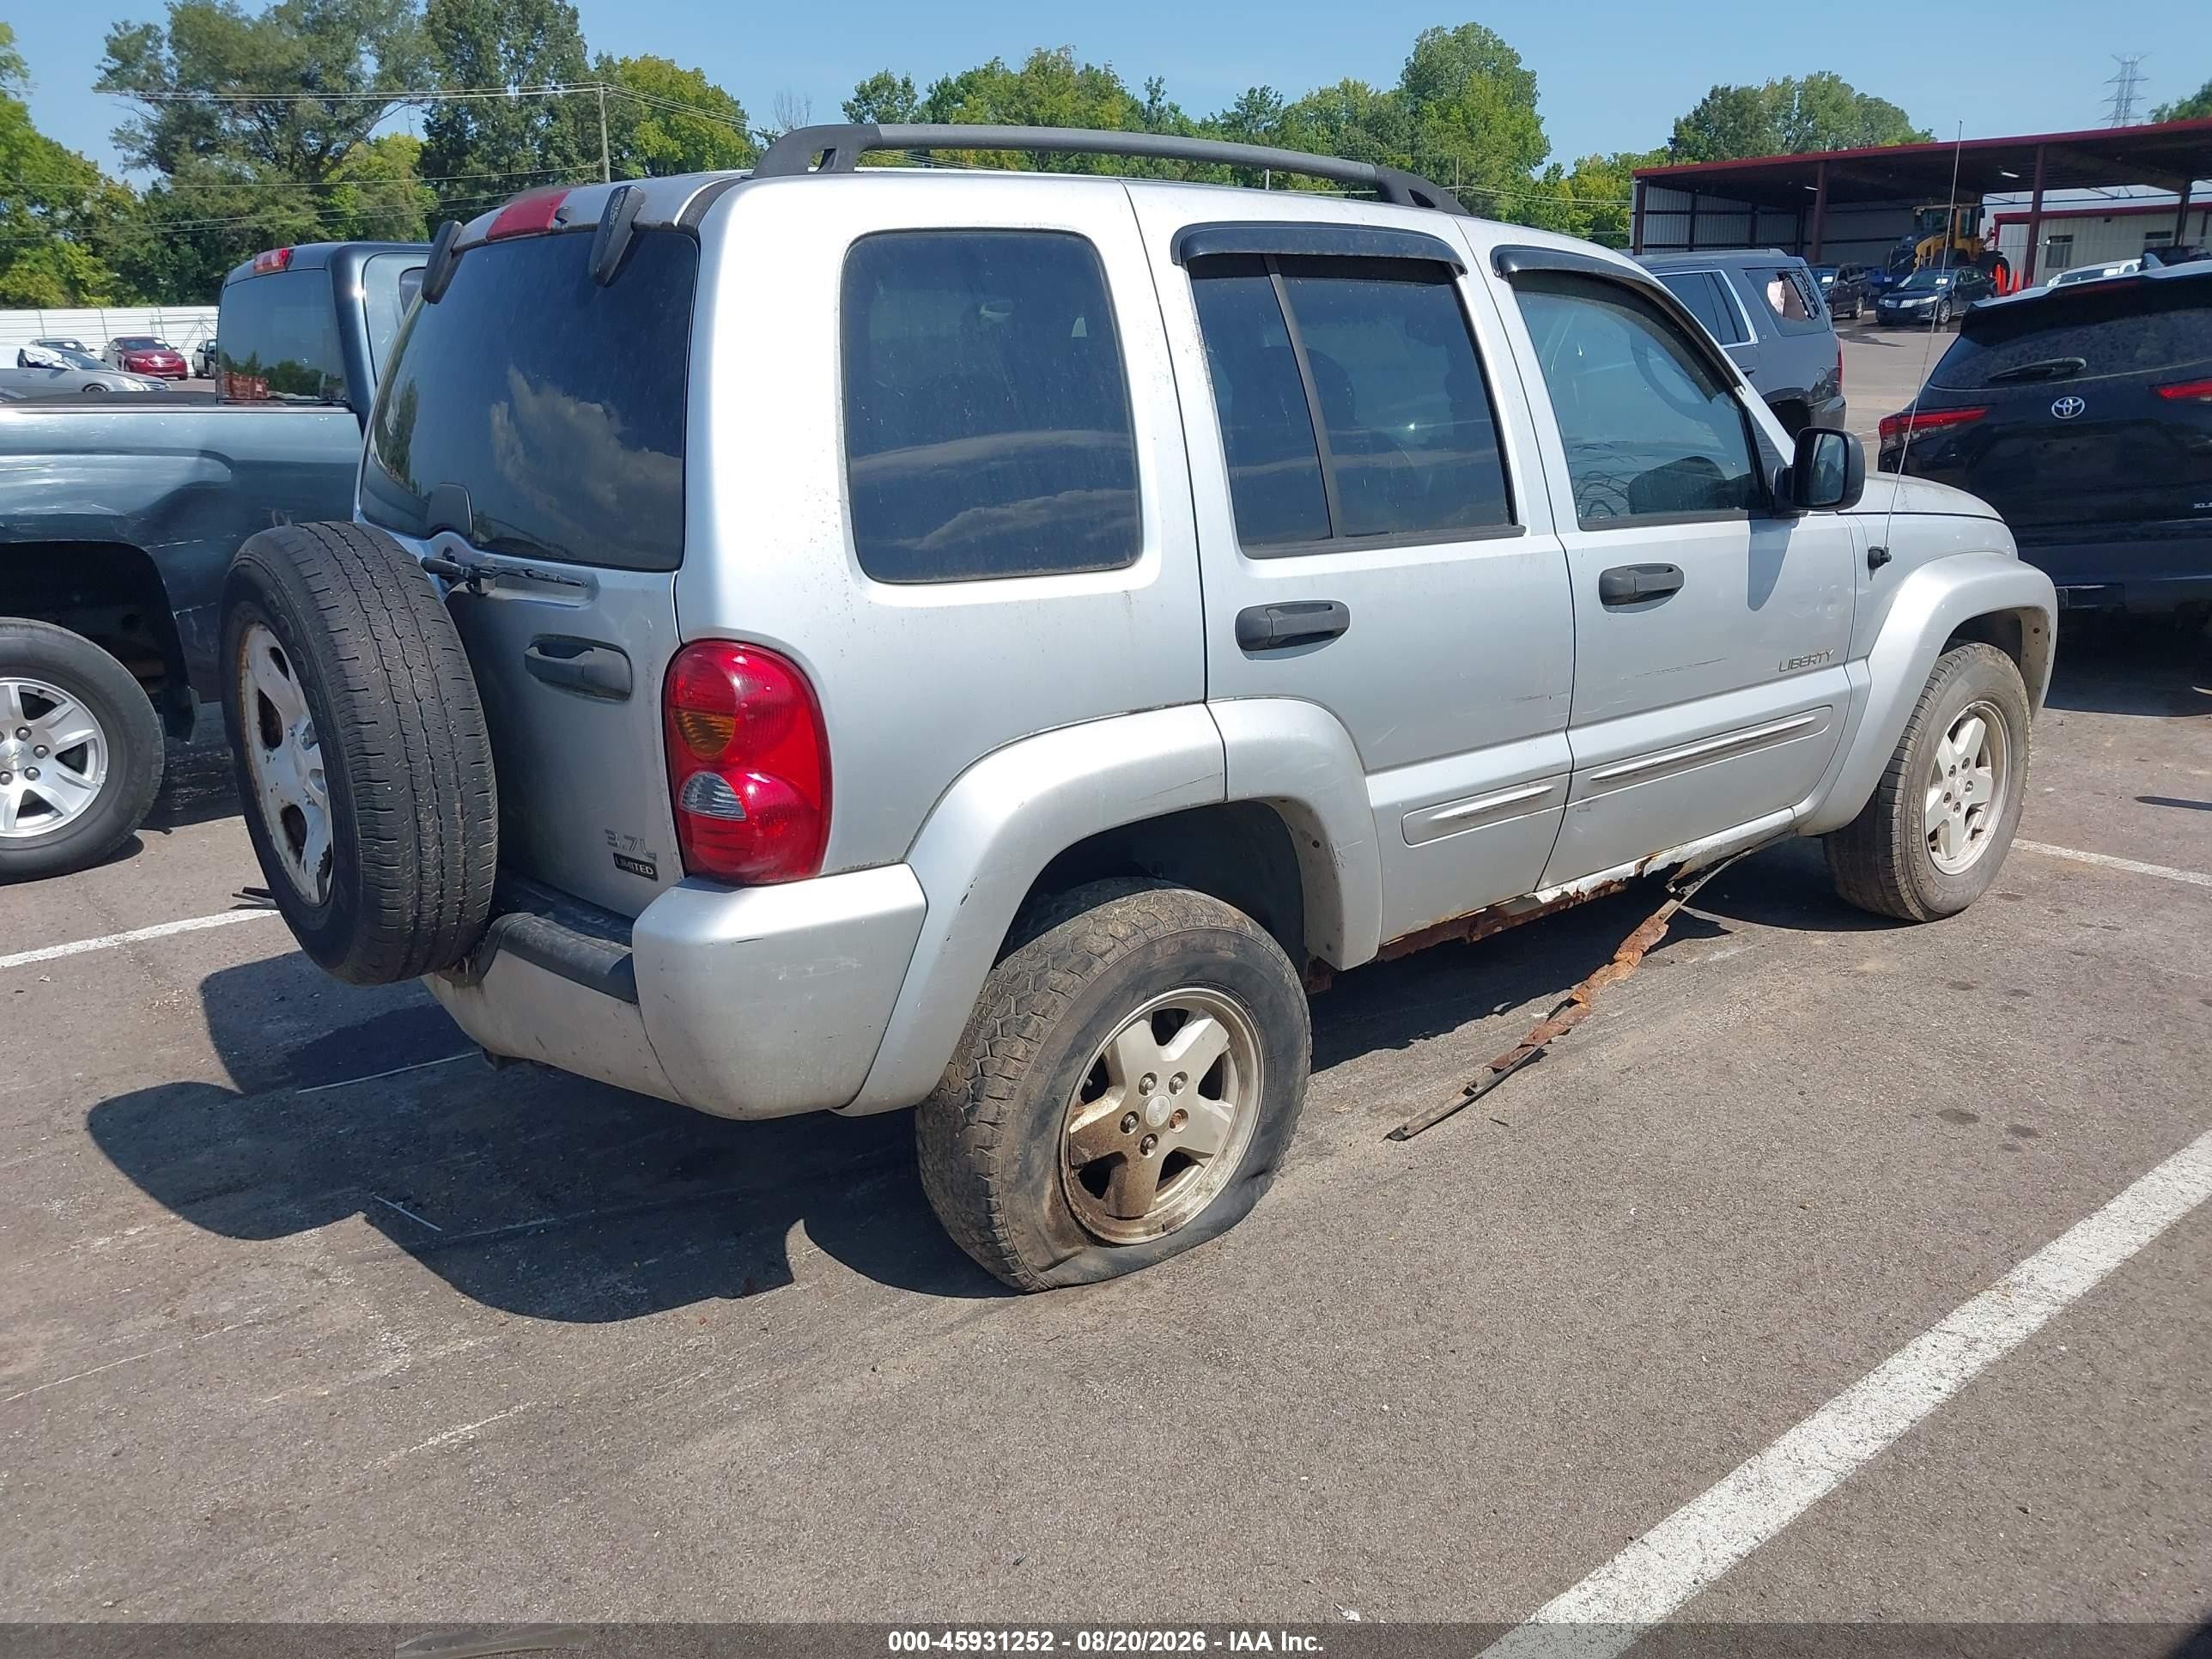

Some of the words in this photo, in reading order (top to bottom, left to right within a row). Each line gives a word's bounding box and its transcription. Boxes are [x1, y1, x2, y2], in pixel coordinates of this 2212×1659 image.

[1778, 647, 1834, 672] LIBERTY
[605, 829, 657, 860] 3.7L
[615, 856, 653, 875] LIMITED
